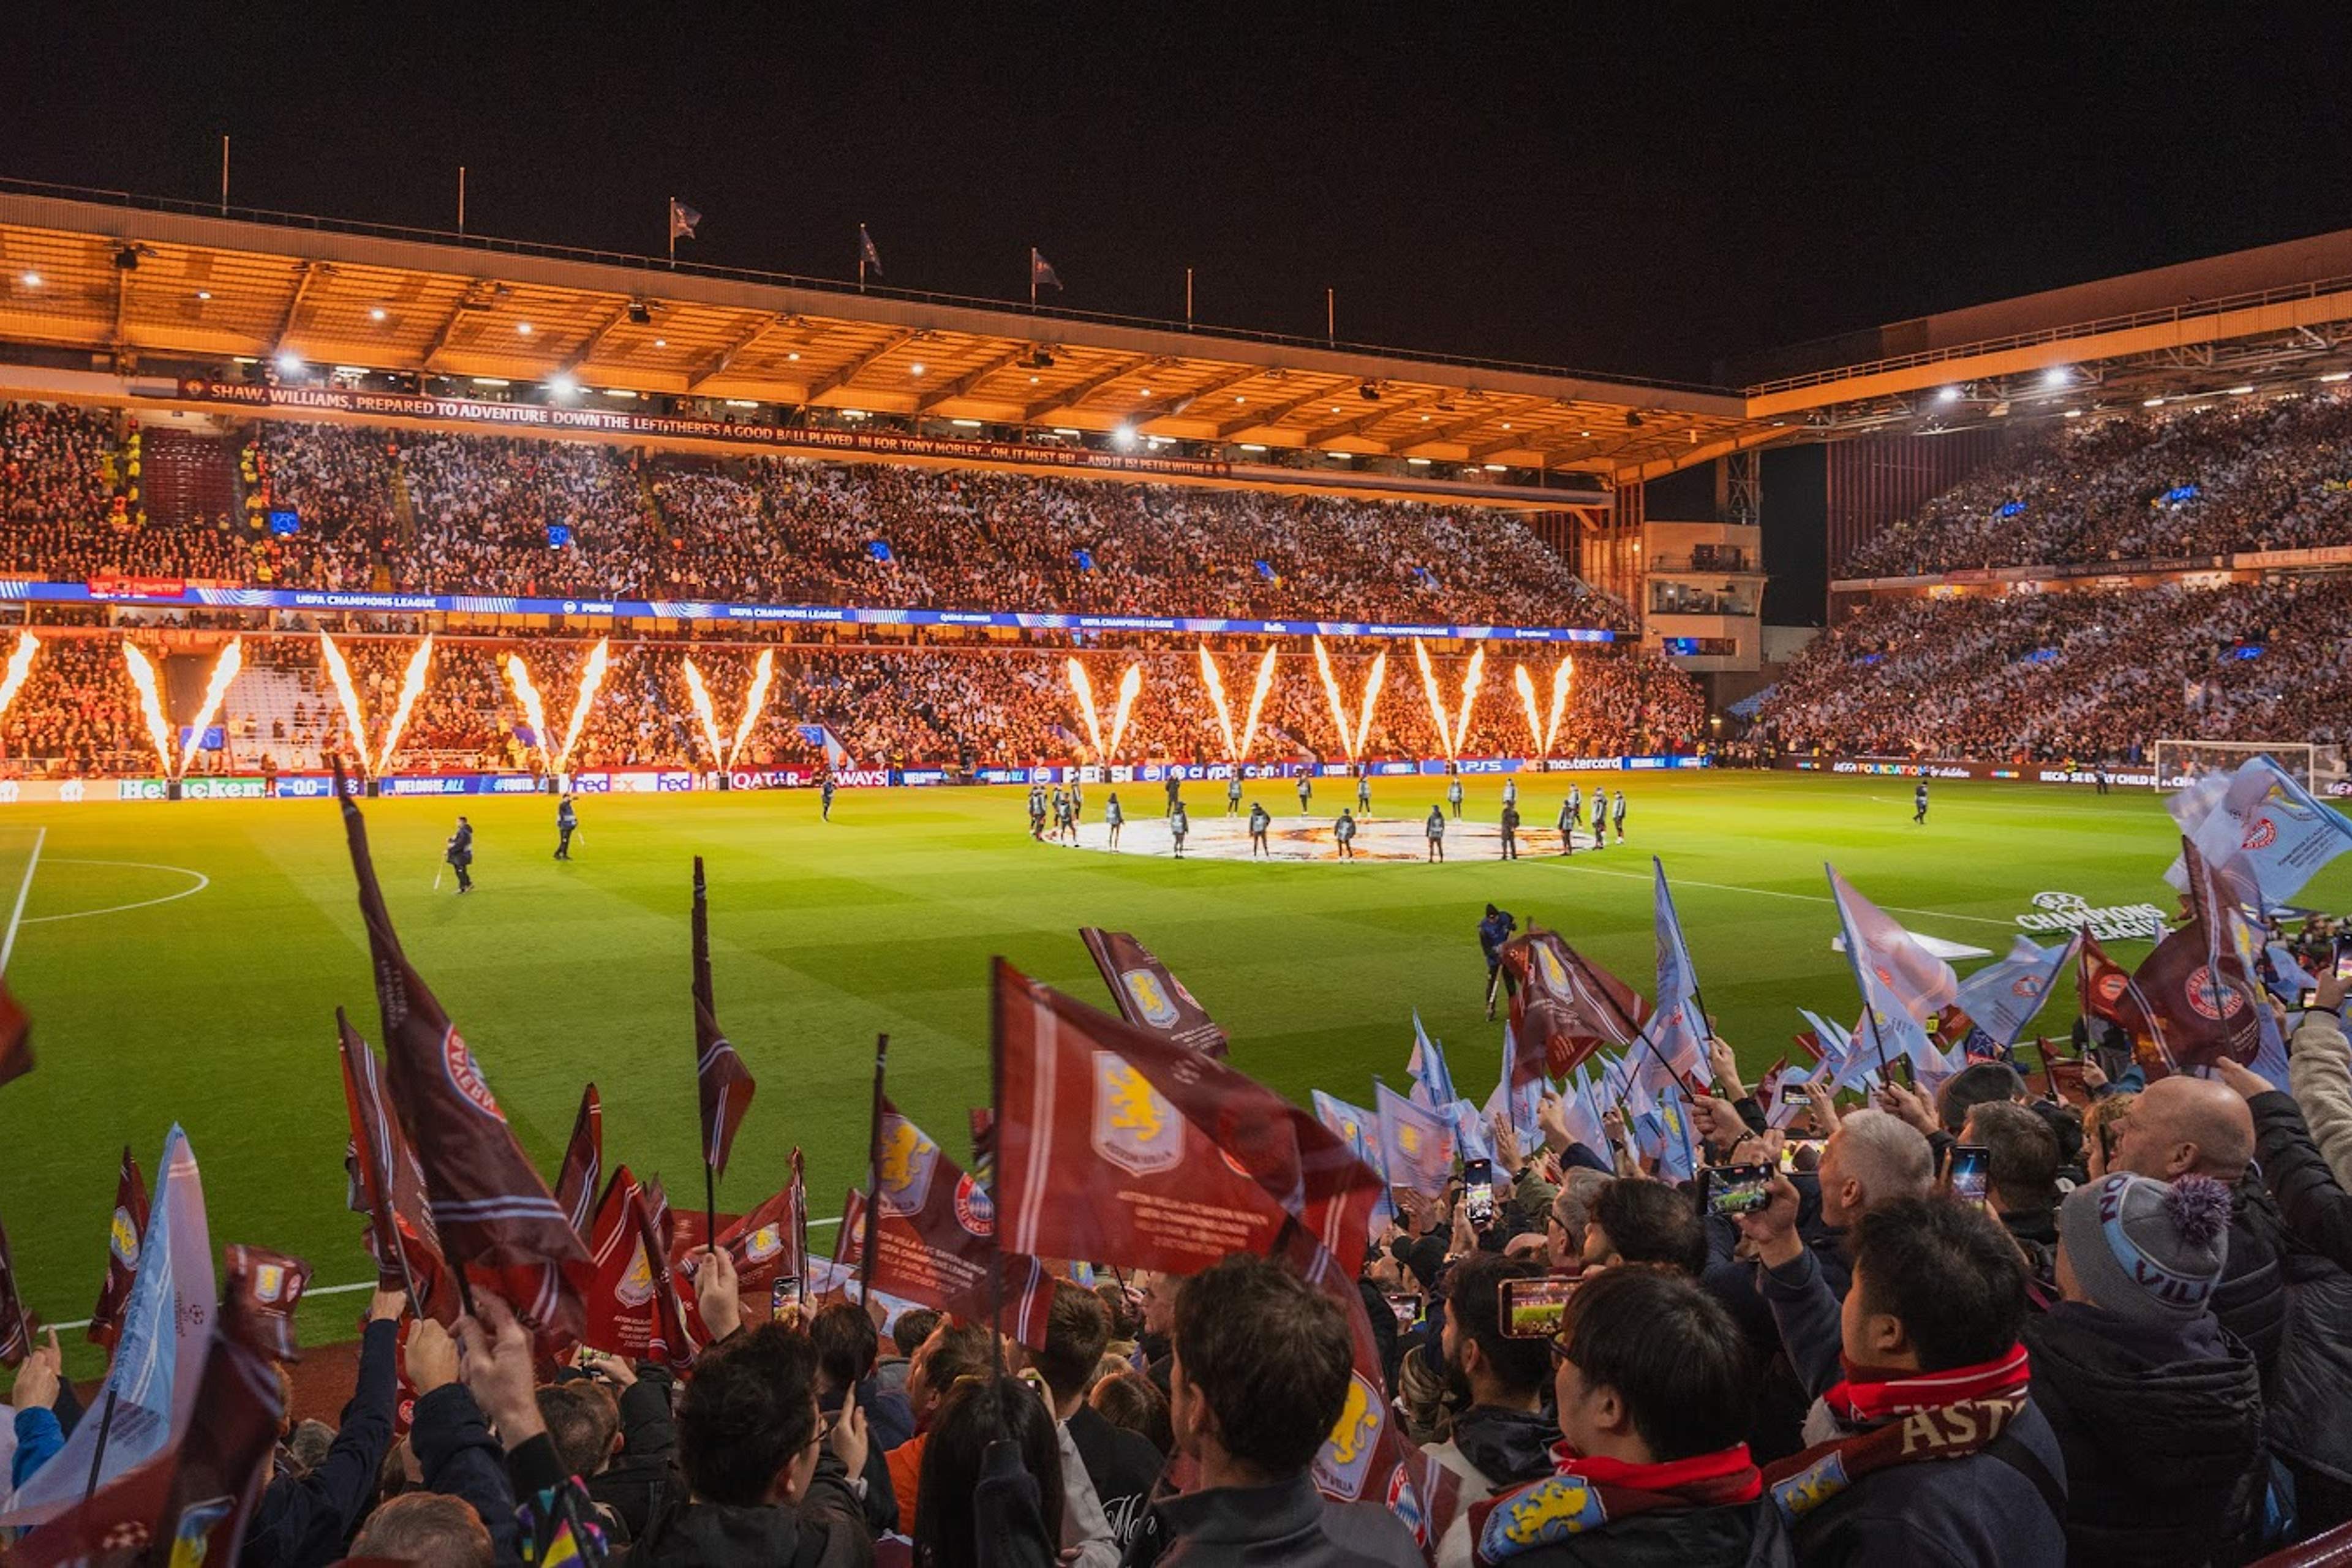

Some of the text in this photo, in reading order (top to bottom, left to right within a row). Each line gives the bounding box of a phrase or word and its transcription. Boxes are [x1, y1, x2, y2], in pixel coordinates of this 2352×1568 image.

[211, 385, 266, 402] SHAW,
[270, 389, 353, 410] WILLIAMS,
[357, 398, 434, 414] PREPARED
[437, 402, 459, 415] TO
[460, 404, 547, 423] ADVENTURE
[554, 412, 600, 426] DOWN
[602, 415, 629, 429] THE
[668, 419, 720, 435] THERE'S
[723, 424, 732, 436] A
[734, 426, 772, 440] GOOD
[777, 429, 805, 443] BALL
[809, 431, 852, 445] PLAYED
[859, 437, 871, 448] IN
[874, 437, 898, 450] FOR
[900, 439, 934, 453] TONY
[1012, 448, 1023, 459] IT
[1025, 449, 1057, 462] MUST
[1112, 456, 1123, 467] IT
[1140, 458, 1171, 471] PETER
[296, 594, 437, 608] UEFA CHAMPIONS LEAGUE
[1550, 757, 1620, 771] mastercard
[1858, 763, 1927, 776] FOUNDATION
[443, 778, 465, 792] ALL
